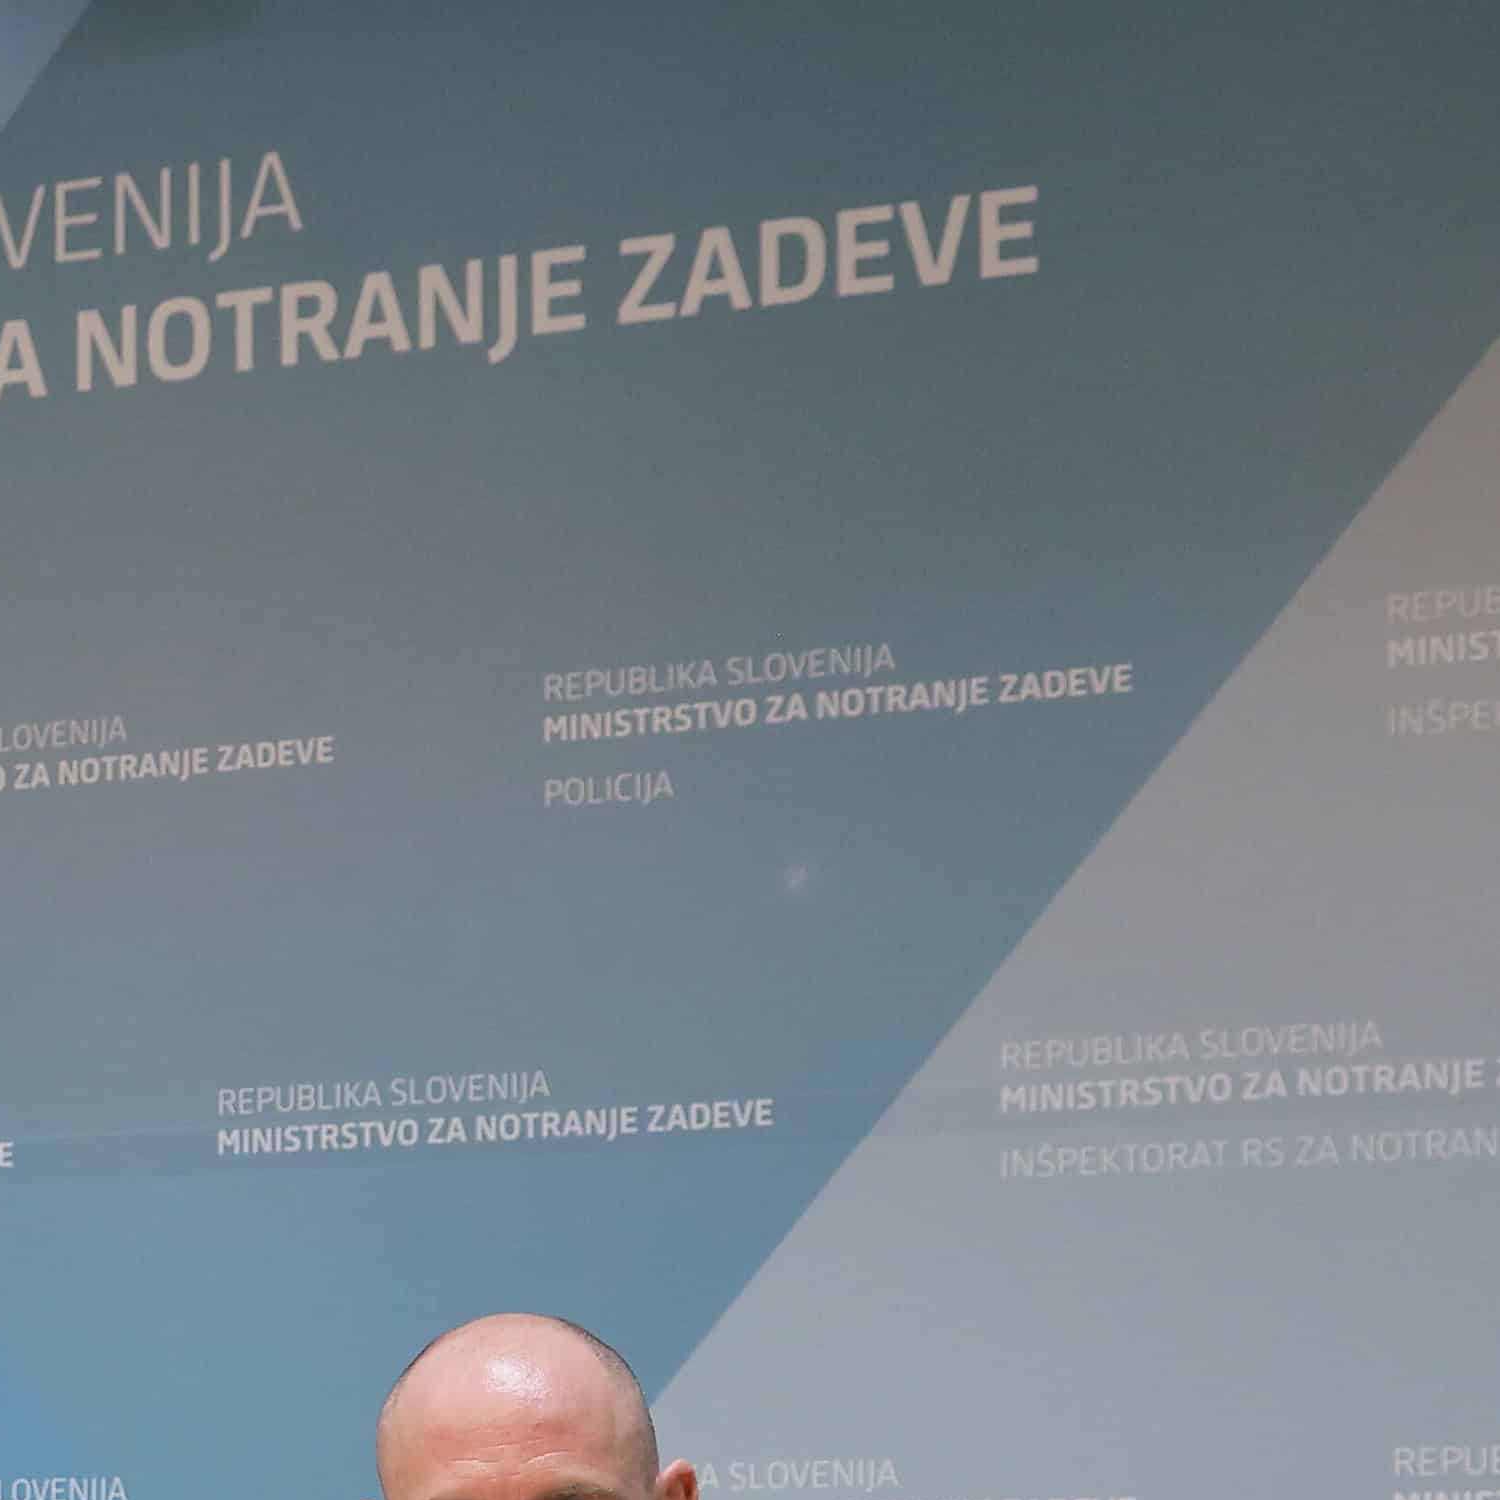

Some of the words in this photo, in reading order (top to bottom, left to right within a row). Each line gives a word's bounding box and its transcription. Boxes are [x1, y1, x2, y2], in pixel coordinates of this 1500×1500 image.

[75, 244, 588, 393] NOTRANJE
[617, 183, 1040, 327] ZADEVE
[543, 659, 717, 701] REPUBLIKA
[727, 643, 895, 686] SLOVENIJA
[1386, 630, 1500, 669] MINIST
[543, 698, 757, 743] MINISTRSTVO
[765, 693, 808, 724] ZA
[816, 676, 989, 719] NOTRANJE
[998, 663, 1133, 703] ZADEVE
[14, 762, 50, 790] ZA
[58, 747, 209, 785] NOTRANJE
[217, 735, 334, 772] ZADEVE
[543, 770, 674, 807] POLICIJA
[1000, 1032, 1190, 1070] REPUBLIKA
[1199, 1020, 1382, 1060] SLOVENIJA
[218, 1080, 382, 1116] REPUBLIKA
[390, 1070, 550, 1106] SLOVENIJA
[1000, 1072, 1233, 1113] MINISTRSTVO
[1242, 1069, 1287, 1101] ZA
[1297, 1058, 1485, 1097] NOTRANJE
[218, 1119, 419, 1155] MINISTRSTVO
[427, 1116, 467, 1145] ZA
[475, 1106, 638, 1142] NOTRANJE
[647, 1098, 773, 1133] ZADEVE
[999, 1140, 1226, 1178] INŠPEKTORAT
[1241, 1136, 1285, 1168] RS
[1295, 1135, 1339, 1167] ZA
[1351, 1127, 1498, 1162] NOTRAN
[729, 1458, 899, 1493] SLOVENIJA
